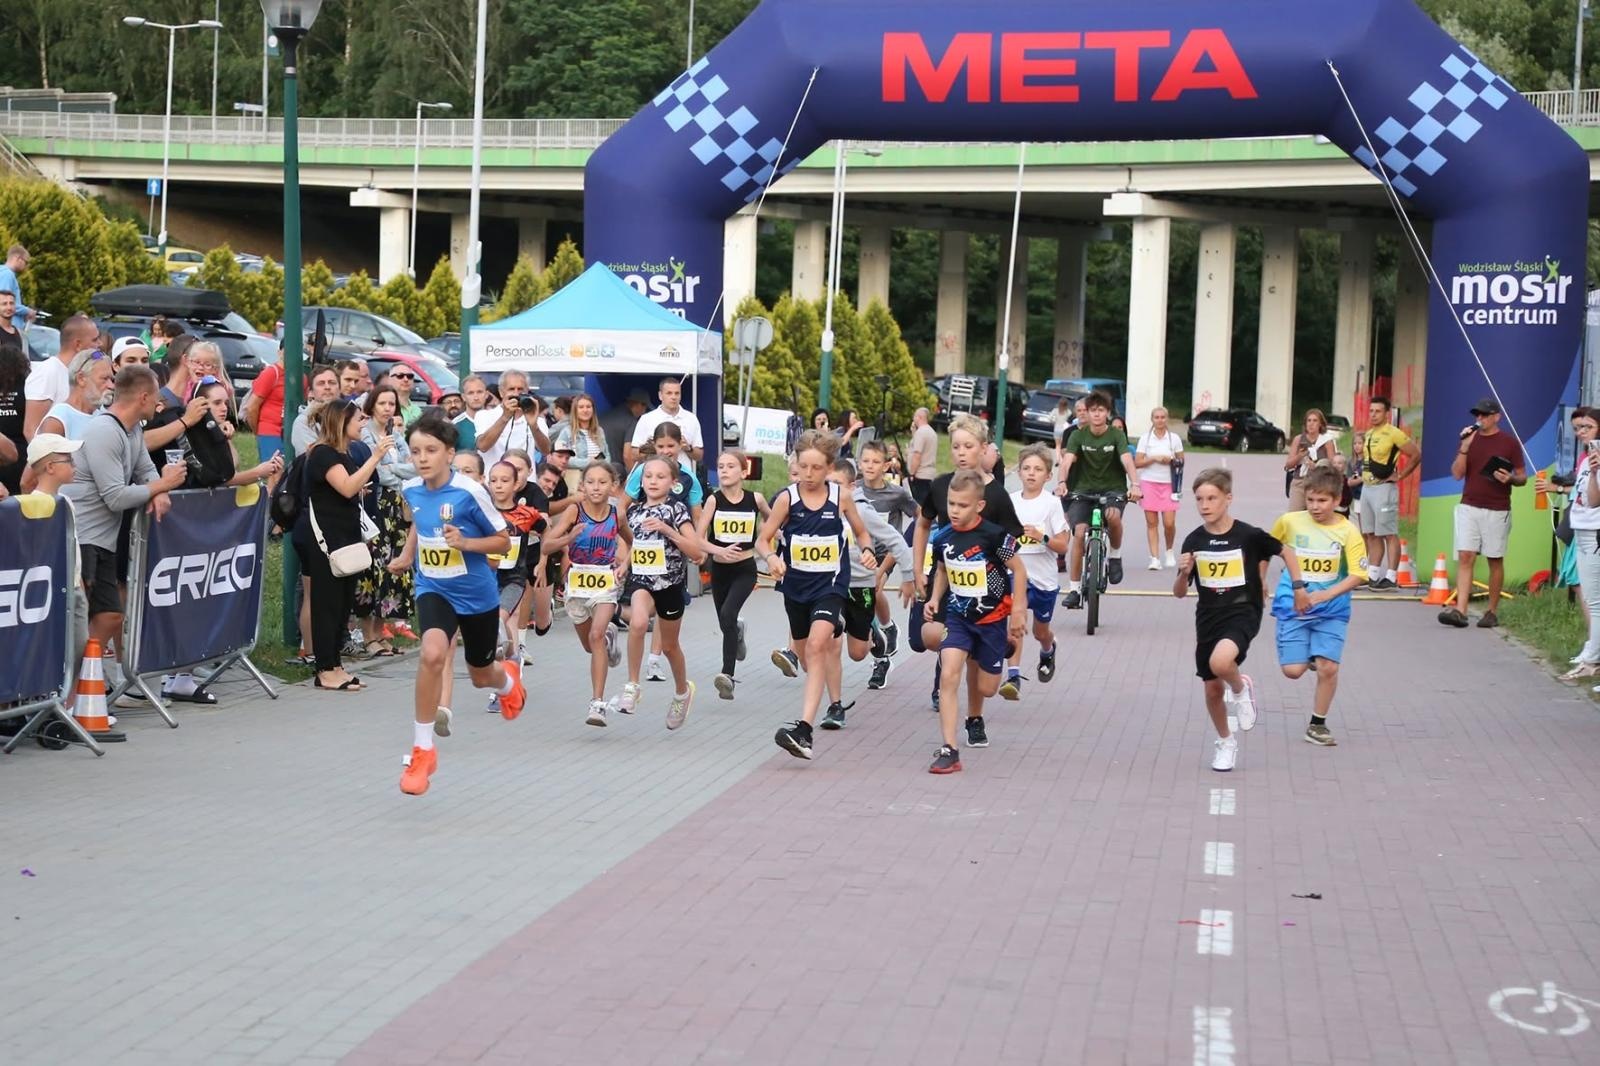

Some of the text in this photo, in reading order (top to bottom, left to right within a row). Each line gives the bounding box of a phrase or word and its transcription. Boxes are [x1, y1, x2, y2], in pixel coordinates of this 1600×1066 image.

[881, 28, 1259, 103] META
[641, 260, 668, 274] Śląski
[1458, 259, 1544, 274] Wodzisław Śląski
[1452, 273, 1573, 305] mosir
[1462, 305, 1558, 325] centrum
[485, 344, 566, 358] PersonalBest
[720, 520, 747, 534] 101
[422, 549, 451, 567] 107
[633, 549, 657, 565] 139
[799, 546, 831, 562] 104
[1208, 562, 1229, 577] 97
[1303, 558, 1332, 573] 103
[148, 542, 257, 607] ERIGO
[577, 574, 607, 588] 106
[950, 570, 978, 587] 110
